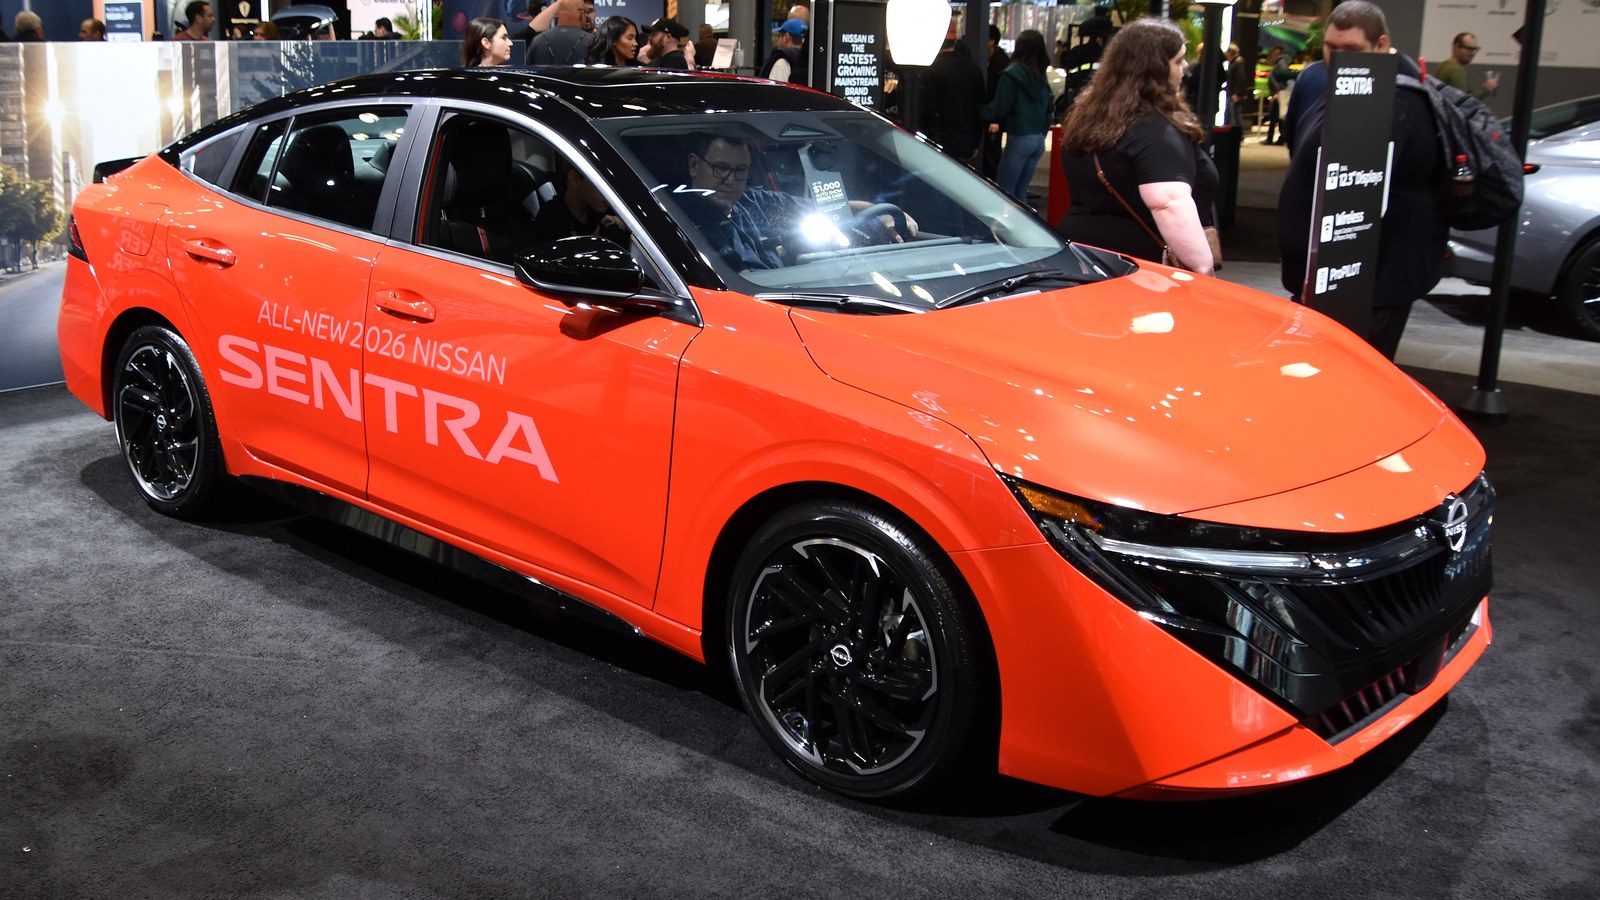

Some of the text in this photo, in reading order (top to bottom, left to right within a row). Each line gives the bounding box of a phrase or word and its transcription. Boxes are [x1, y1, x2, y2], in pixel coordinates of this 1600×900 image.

[842, 33, 875, 44] NISSAN IS
[851, 43, 865, 53] THE
[838, 53, 877, 65] FASTEST-
[837, 65, 877, 77] GROWING
[834, 77, 879, 87] MAINSTREAM
[844, 86, 869, 96] BRAND
[861, 96, 874, 105] U.S.
[812, 180, 840, 194] $1,000
[1329, 261, 1362, 281] ProPILOT
[257, 300, 507, 386] ALL-NEW 2026 NISSAN
[217, 333, 560, 484] SENTRA
